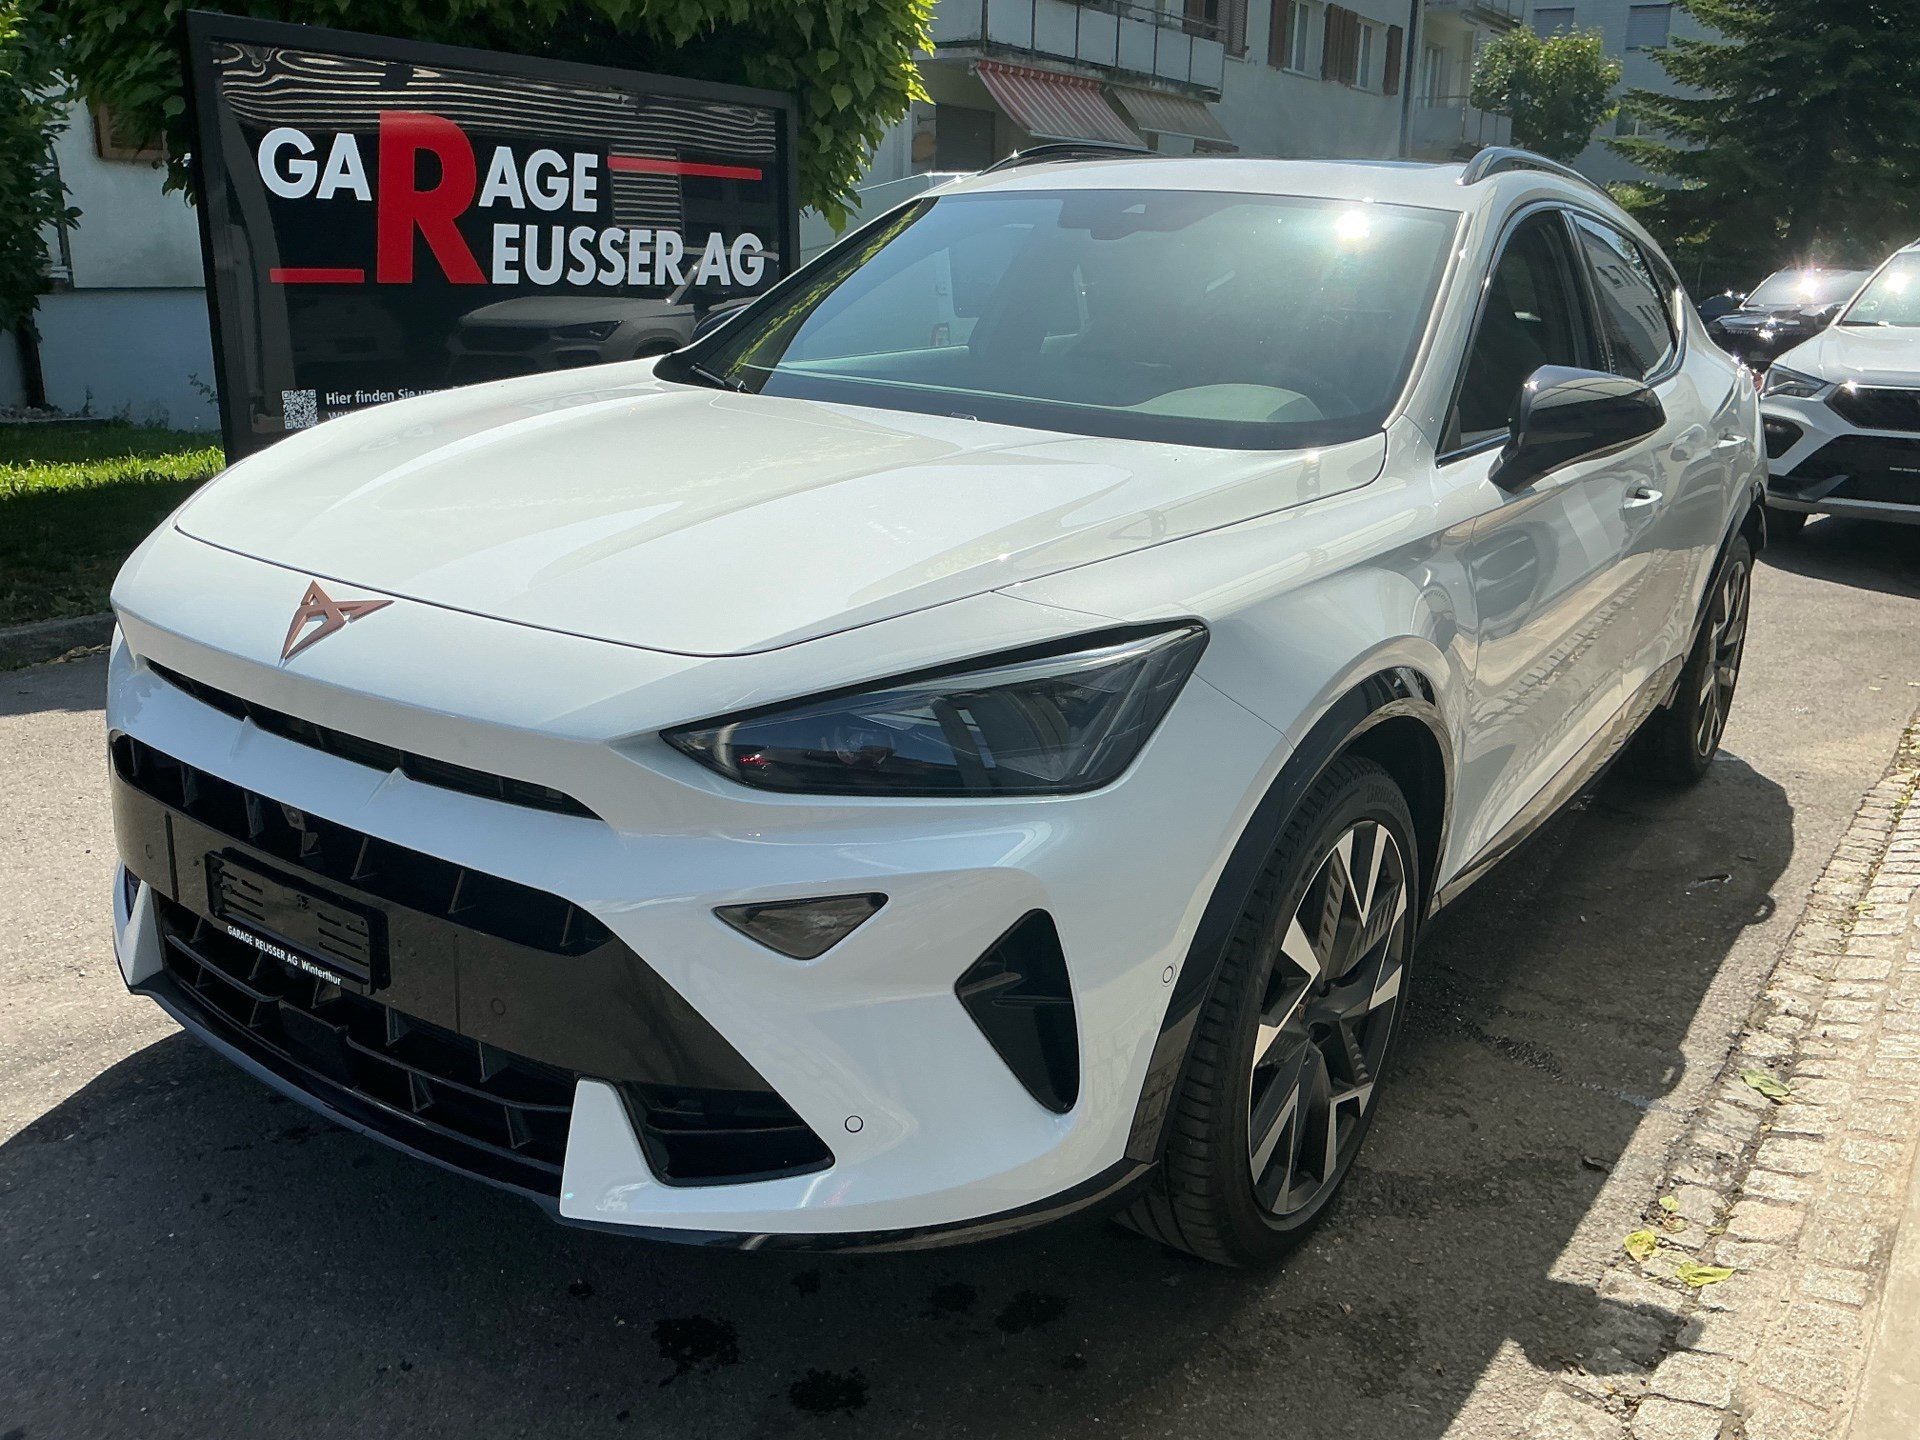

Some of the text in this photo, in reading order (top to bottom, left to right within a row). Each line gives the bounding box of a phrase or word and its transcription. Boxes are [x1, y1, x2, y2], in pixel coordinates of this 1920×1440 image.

[258, 110, 598, 284] GARAGE
[695, 232, 765, 287] AG
[326, 391, 352, 405] Hier
[355, 389, 395, 403] finden
[398, 388, 416, 400] Sie
[227, 925, 341, 985] GARAGE REUSSER AG Winterthur
